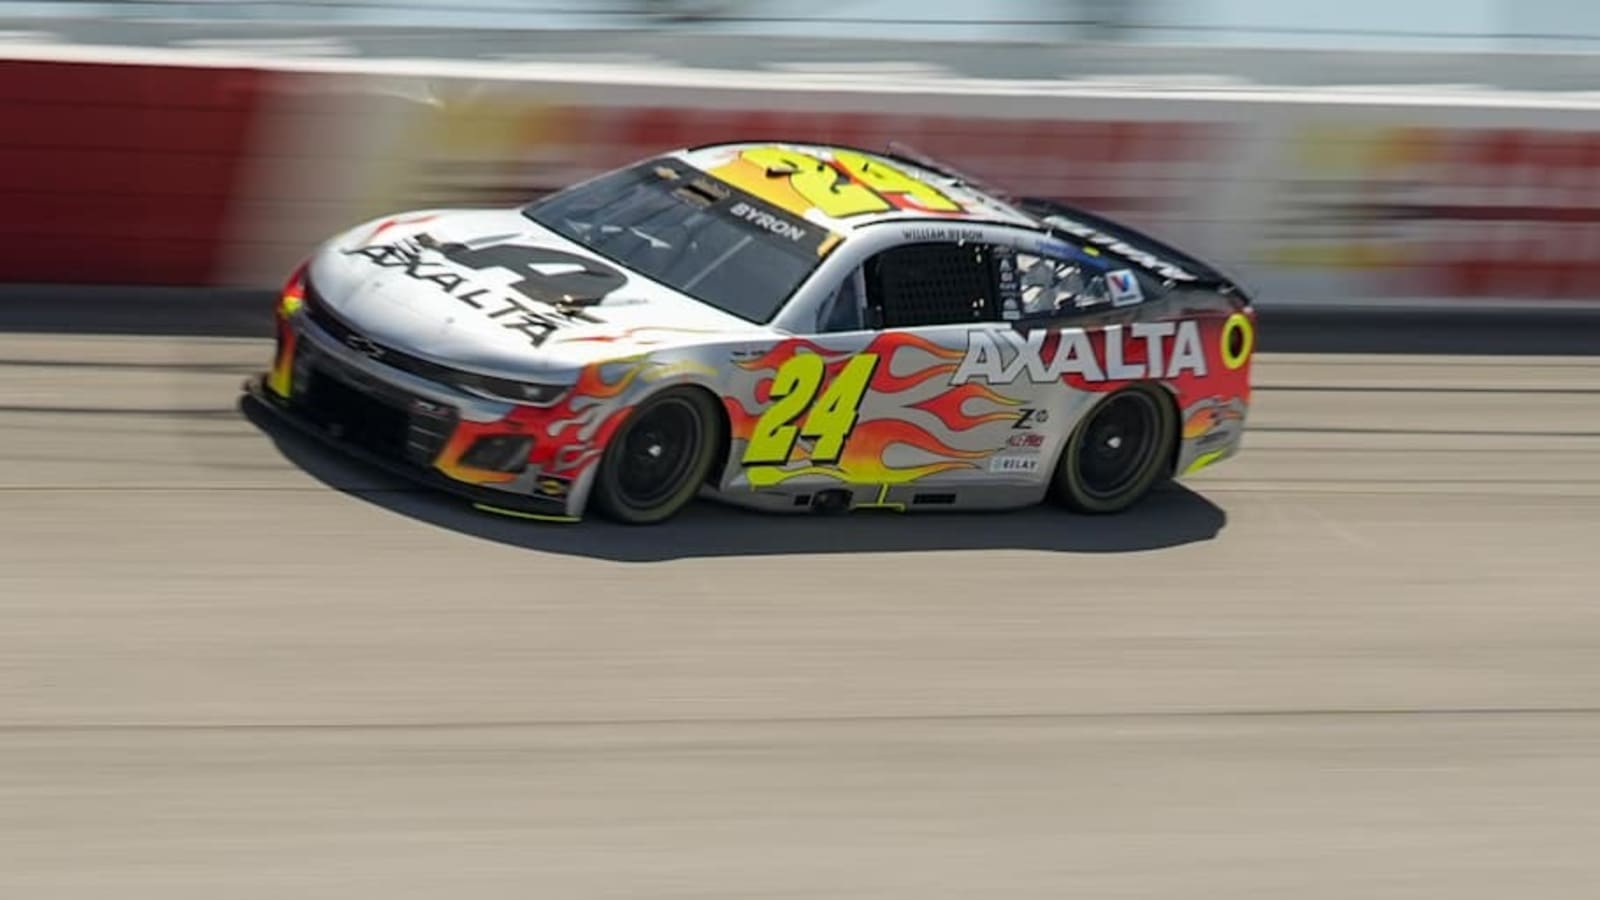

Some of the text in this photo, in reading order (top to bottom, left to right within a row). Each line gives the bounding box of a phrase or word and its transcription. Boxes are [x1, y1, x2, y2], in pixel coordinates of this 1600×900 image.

[730, 202, 806, 242] BYRON
[903, 228, 945, 240] WILLIAM
[340, 243, 558, 347] AXALTA
[951, 320, 1207, 387] AXALTA
[742, 352, 879, 466] 24
